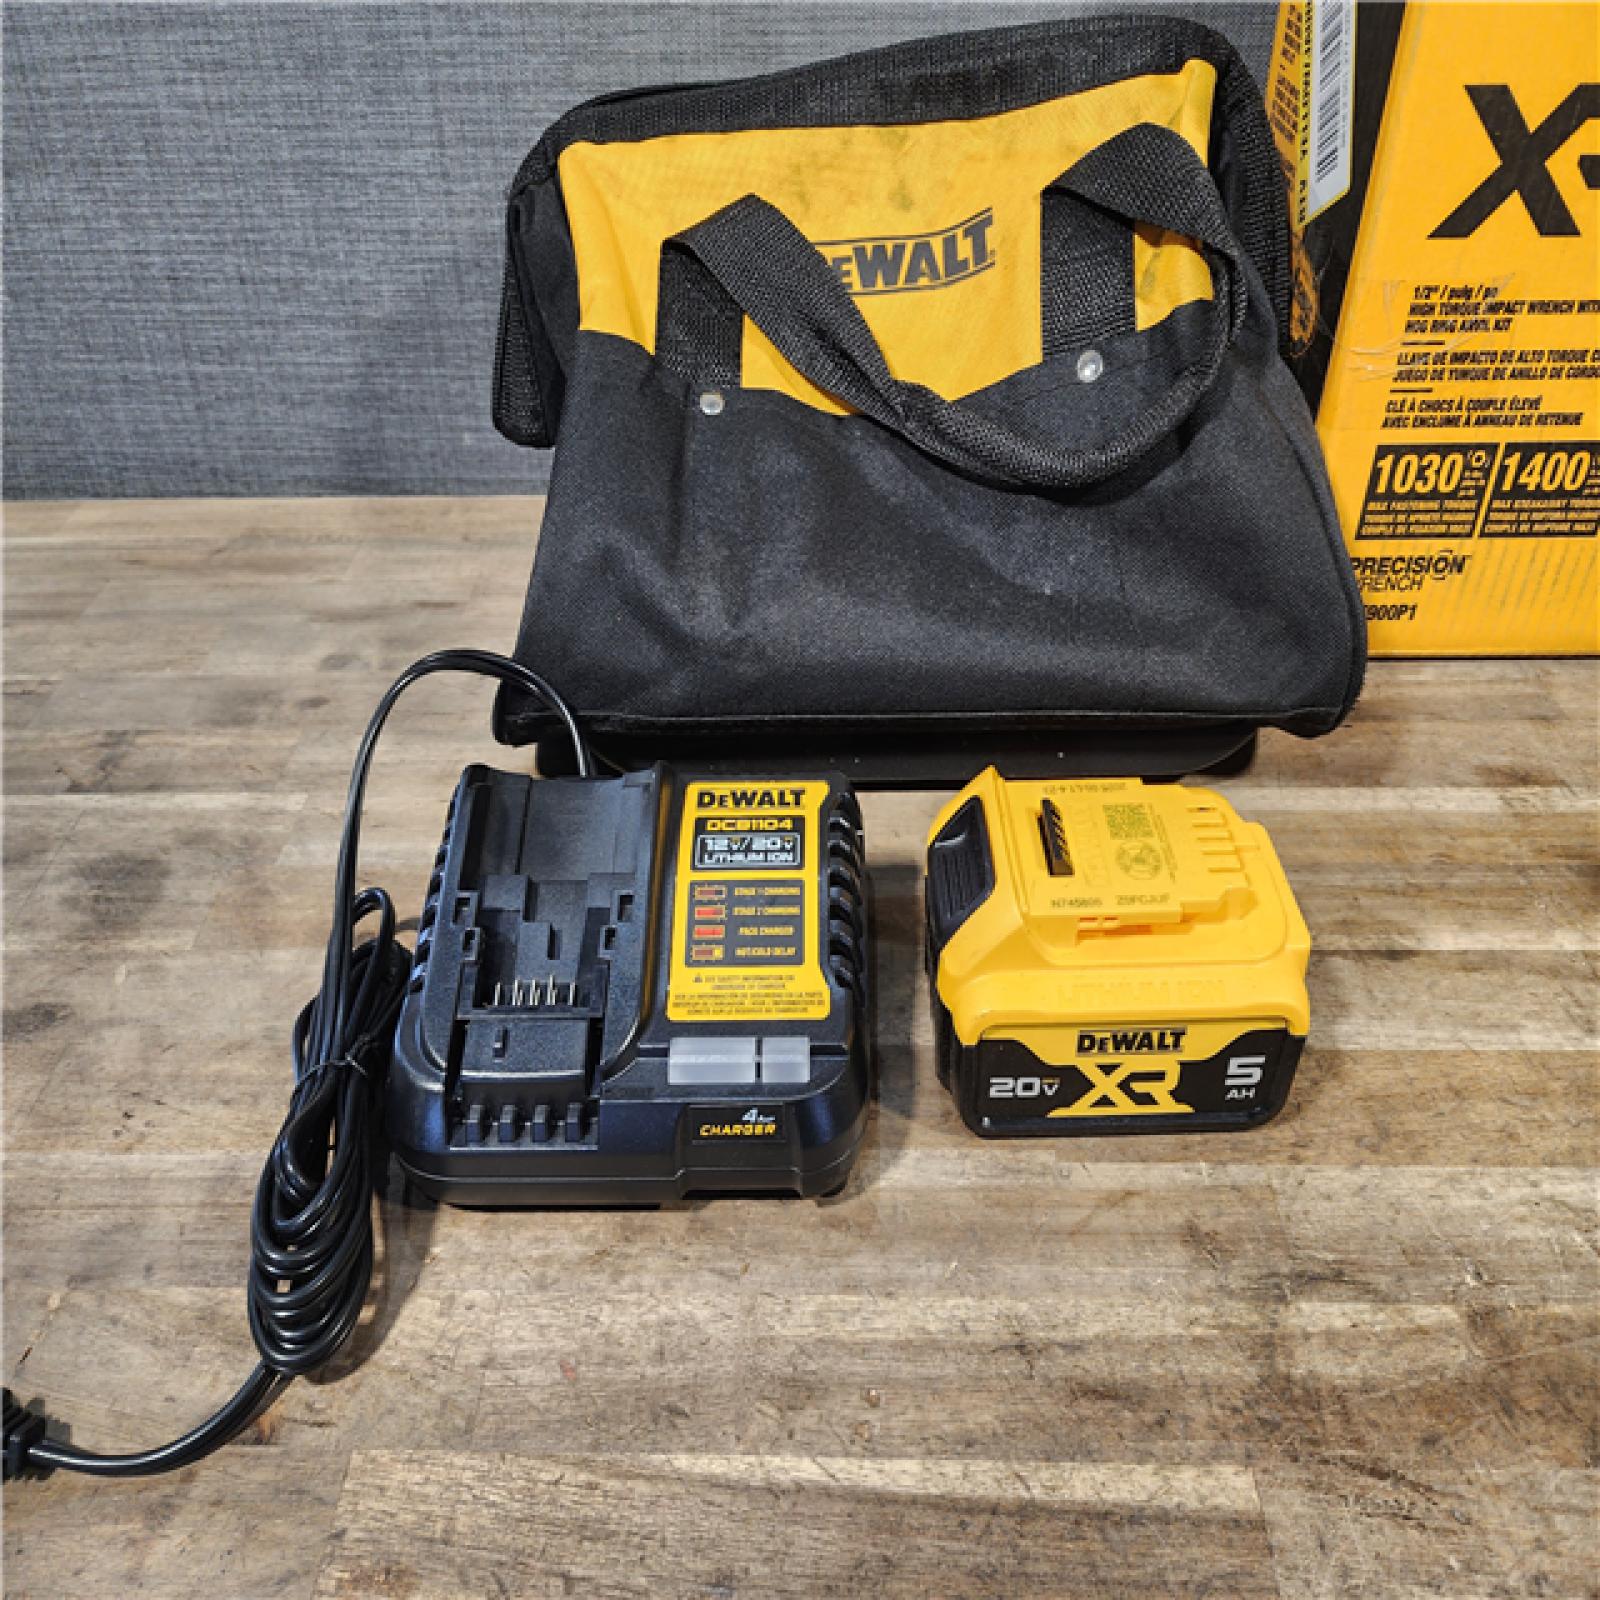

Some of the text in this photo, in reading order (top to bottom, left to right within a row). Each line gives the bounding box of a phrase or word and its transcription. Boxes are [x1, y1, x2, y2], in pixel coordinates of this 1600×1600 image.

[832, 215, 993, 289] EWALT
[1439, 302, 1480, 316] TORQUE
[1485, 301, 1526, 315] IMPACT
[1528, 300, 1574, 314] WRENCH
[1397, 352, 1430, 366] LLAVE
[1433, 352, 1448, 365] DE
[1450, 351, 1498, 364] IMPACTO
[1500, 350, 1516, 364] DE
[1517, 350, 1545, 364] ALTO
[1548, 350, 1589, 363] TORQUE
[1393, 368, 1428, 382] JUEGO
[1430, 368, 1446, 381] DE
[1492, 367, 1508, 380] DE
[1509, 366, 1547, 380] ANILLO
[1550, 366, 1564, 380] DE
[1418, 399, 1454, 412] CHOCS
[1466, 398, 1507, 412] COUPLE
[1382, 416, 1410, 429] AVEC
[1520, 414, 1533, 426] DE
[1376, 454, 1464, 494] 1030
[1501, 452, 1591, 492] 1400
[1350, 556, 1465, 575] PRECISION
[1358, 575, 1424, 592] RENCH
[1363, 604, 1417, 620] 900P1
[697, 789, 806, 809] DEWALT
[704, 852, 794, 864] LITHIUM ION
[1077, 1030, 1186, 1053] DEWALT
[1224, 1056, 1266, 1086] 5
[1046, 1061, 1195, 1117] XR
[1224, 1087, 1256, 1100] AH
[742, 1107, 758, 1123] 4
[699, 1123, 776, 1136] CHARGER
